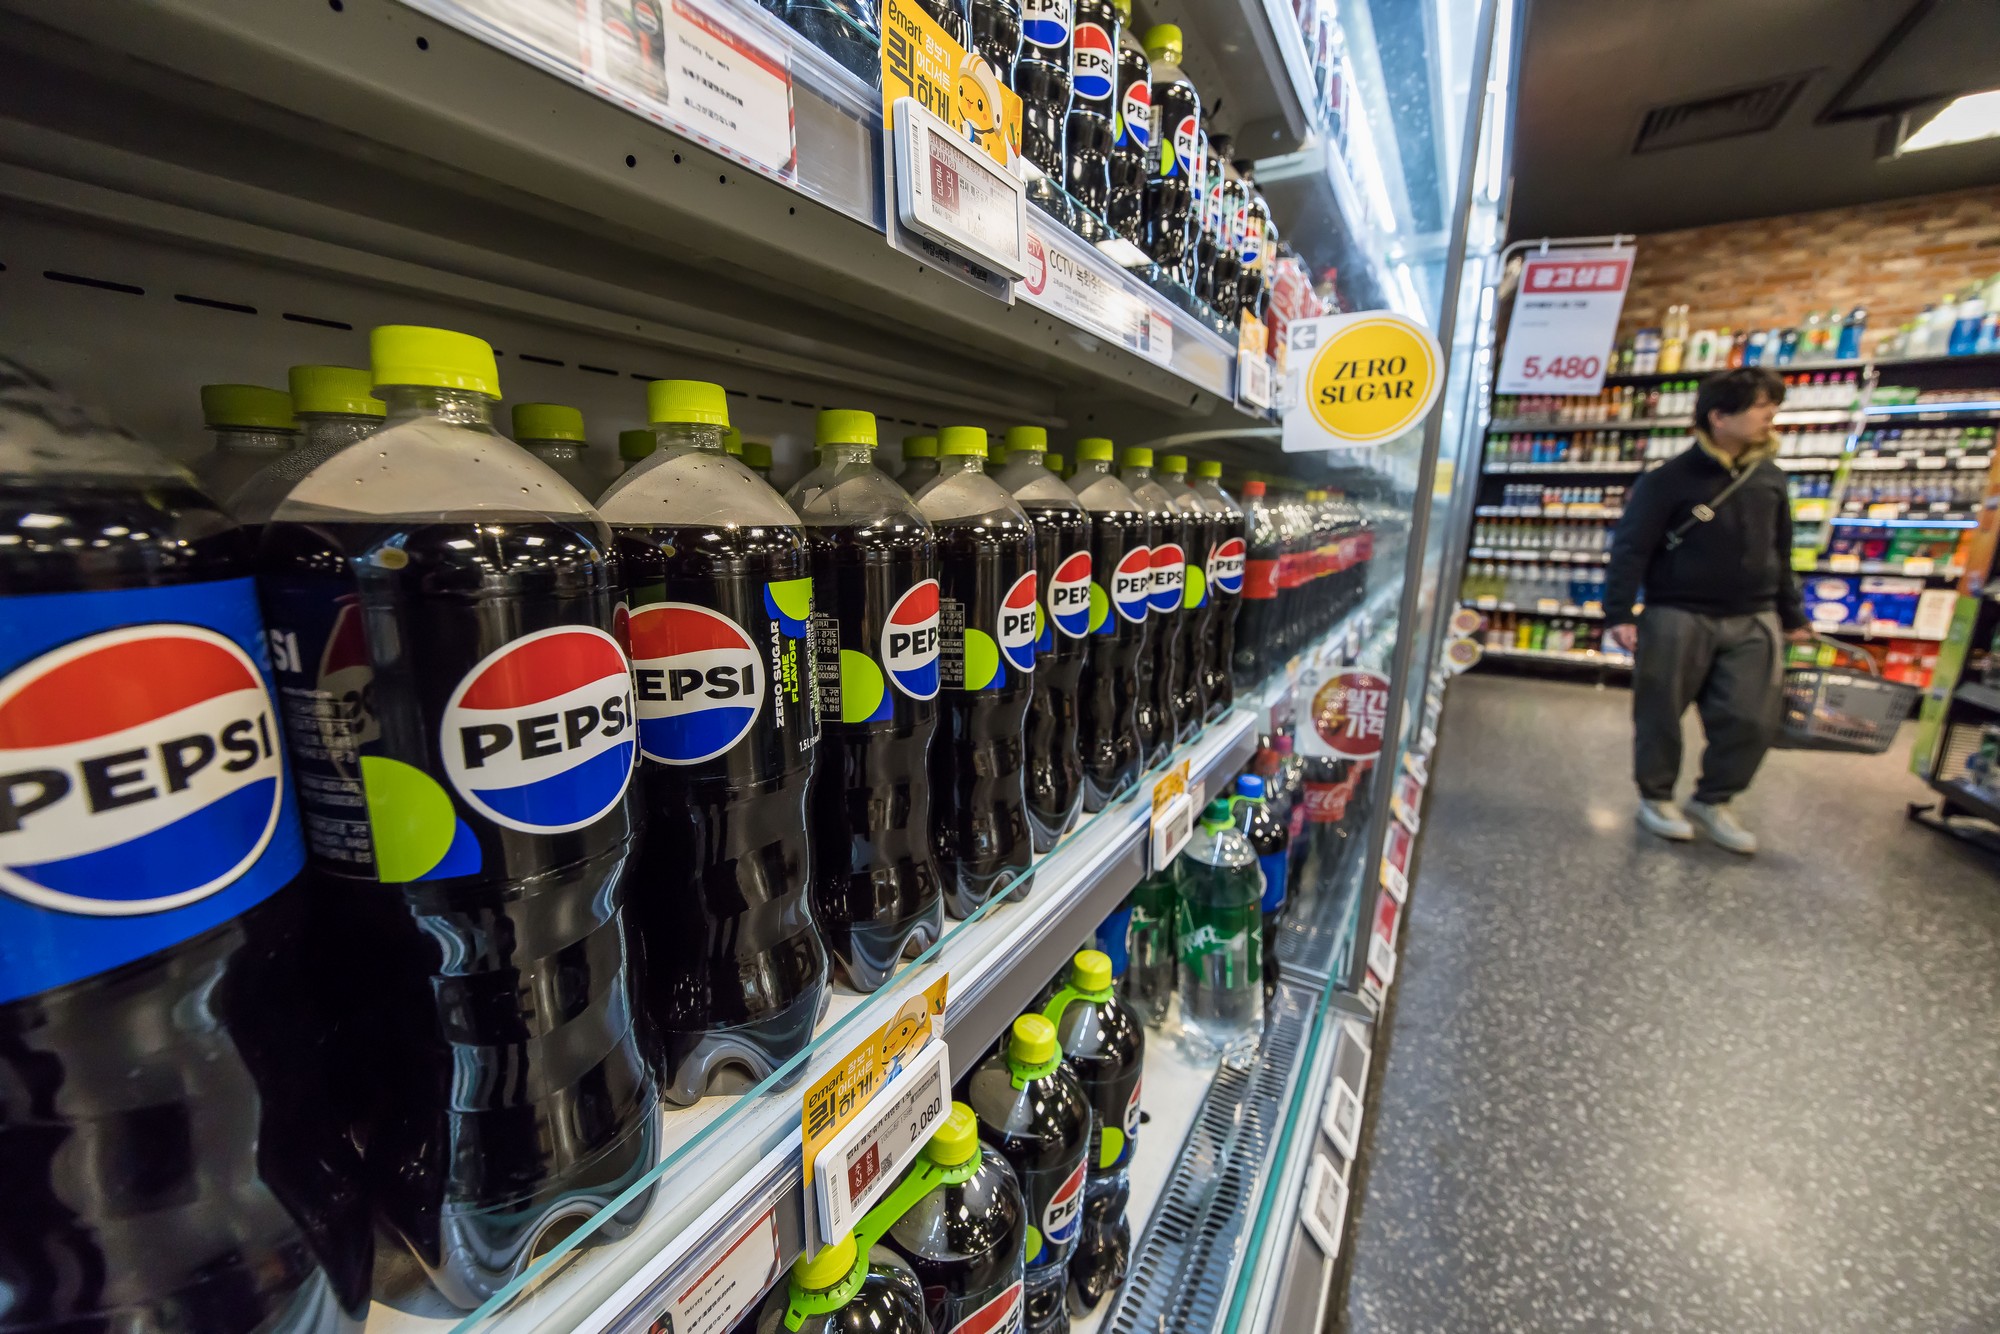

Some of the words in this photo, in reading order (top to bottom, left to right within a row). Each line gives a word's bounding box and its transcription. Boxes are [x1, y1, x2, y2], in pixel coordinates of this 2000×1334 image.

[888, 0, 923, 45] emart
[1026, 0, 1068, 24] EPSI
[915, 50, 951, 92] 어디서든
[925, 33, 951, 71] 장보기
[1073, 52, 1113, 77] EPSI
[1049, 249, 1074, 281] CCTV
[1334, 356, 1408, 381] ZERO
[1523, 355, 1600, 381] 5,480
[1319, 379, 1414, 406] SUGAR
[889, 626, 940, 659] PEP
[1004, 610, 1036, 637] PEP
[770, 620, 781, 682] SUGAR
[632, 663, 755, 702] EPSI
[781, 653, 791, 693] LIME
[788, 638, 799, 704] FLAVOR
[774, 683, 785, 729] ZERO
[459, 690, 633, 770] PEPSI
[0, 711, 274, 836] PEPSI
[837, 1058, 874, 1097] 어디서든
[847, 1043, 875, 1075] 장보기
[808, 1070, 844, 1109] emart
